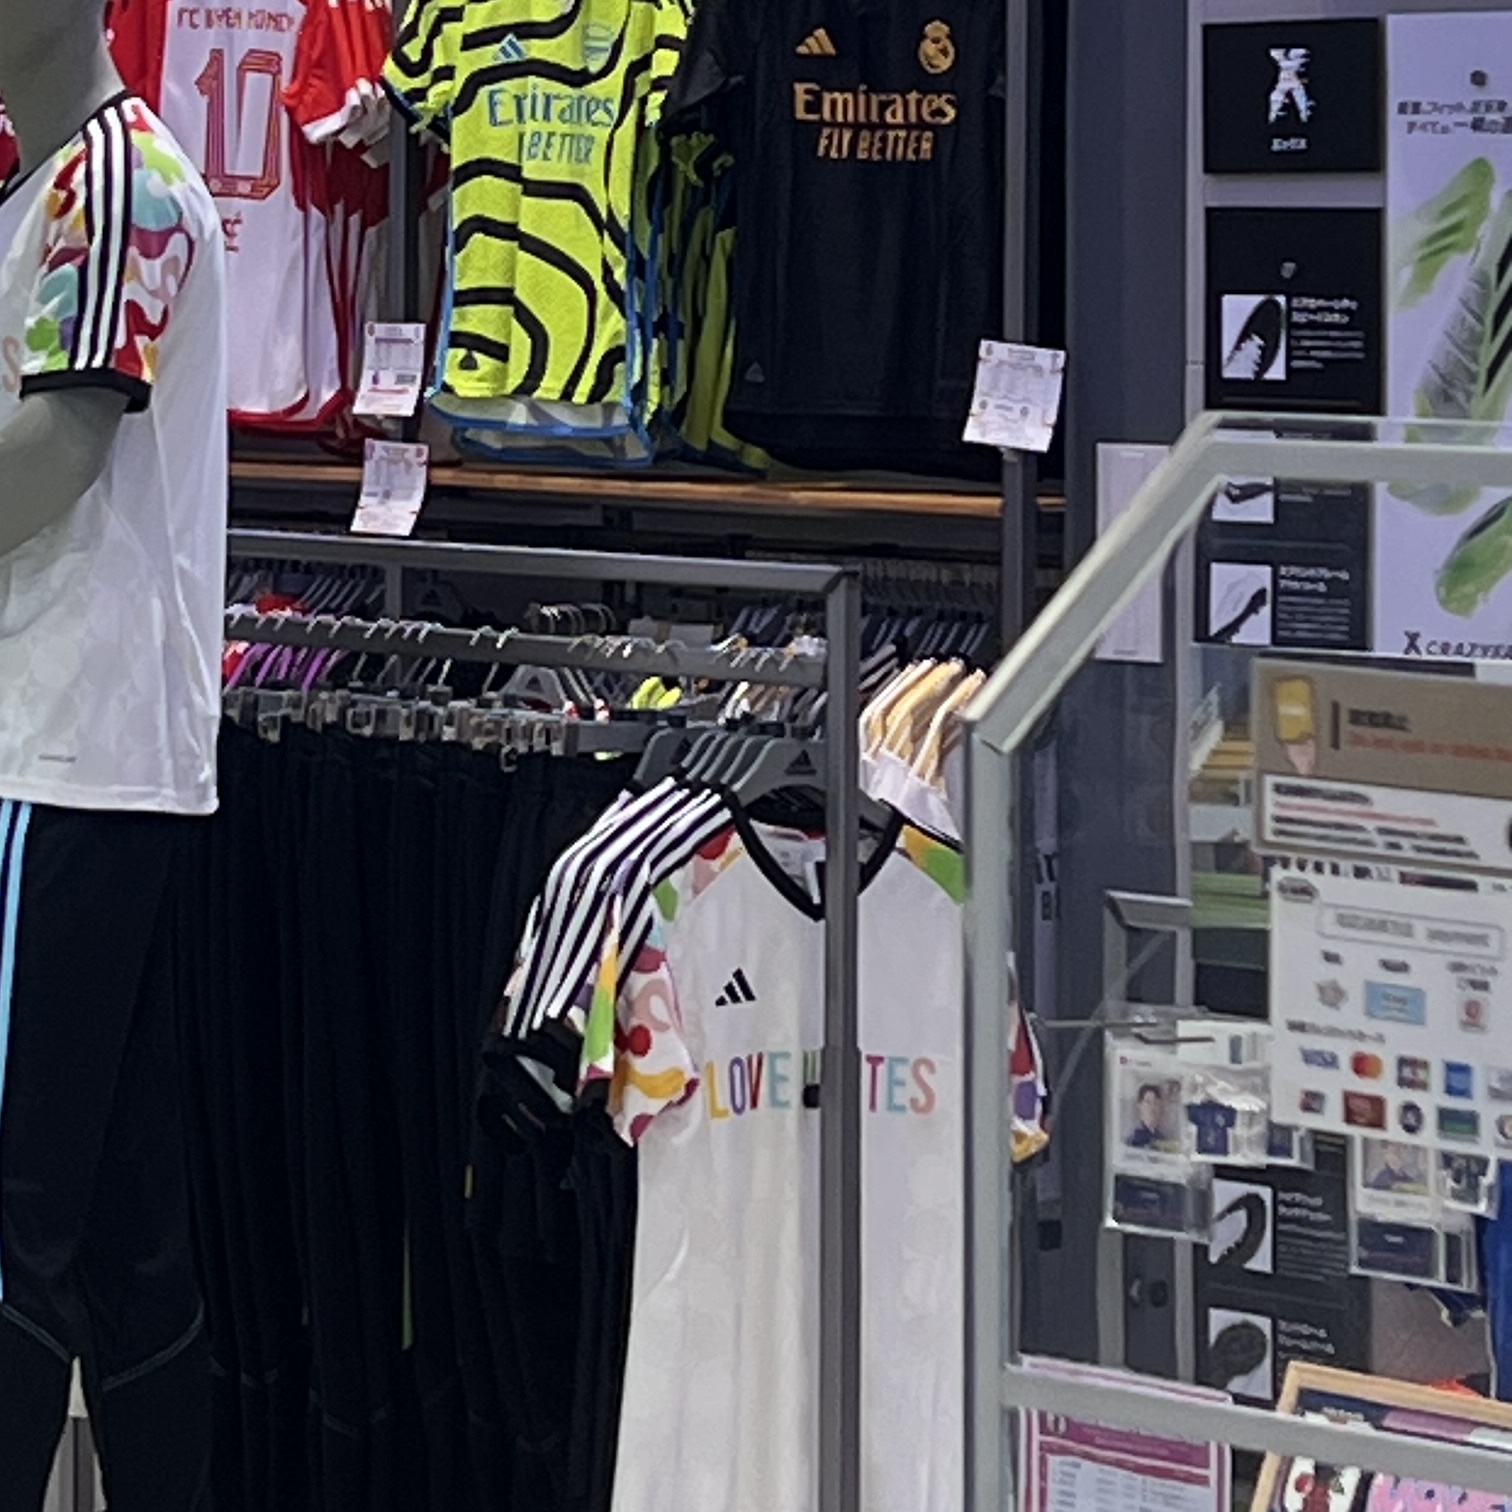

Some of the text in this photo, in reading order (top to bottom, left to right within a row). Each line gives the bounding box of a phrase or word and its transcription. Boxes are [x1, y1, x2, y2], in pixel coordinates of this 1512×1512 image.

[194, 48, 284, 200] 10
[793, 82, 957, 125] Emirates
[856, 129, 935, 162] BETTER
[705, 1052, 793, 1119] LOVE
